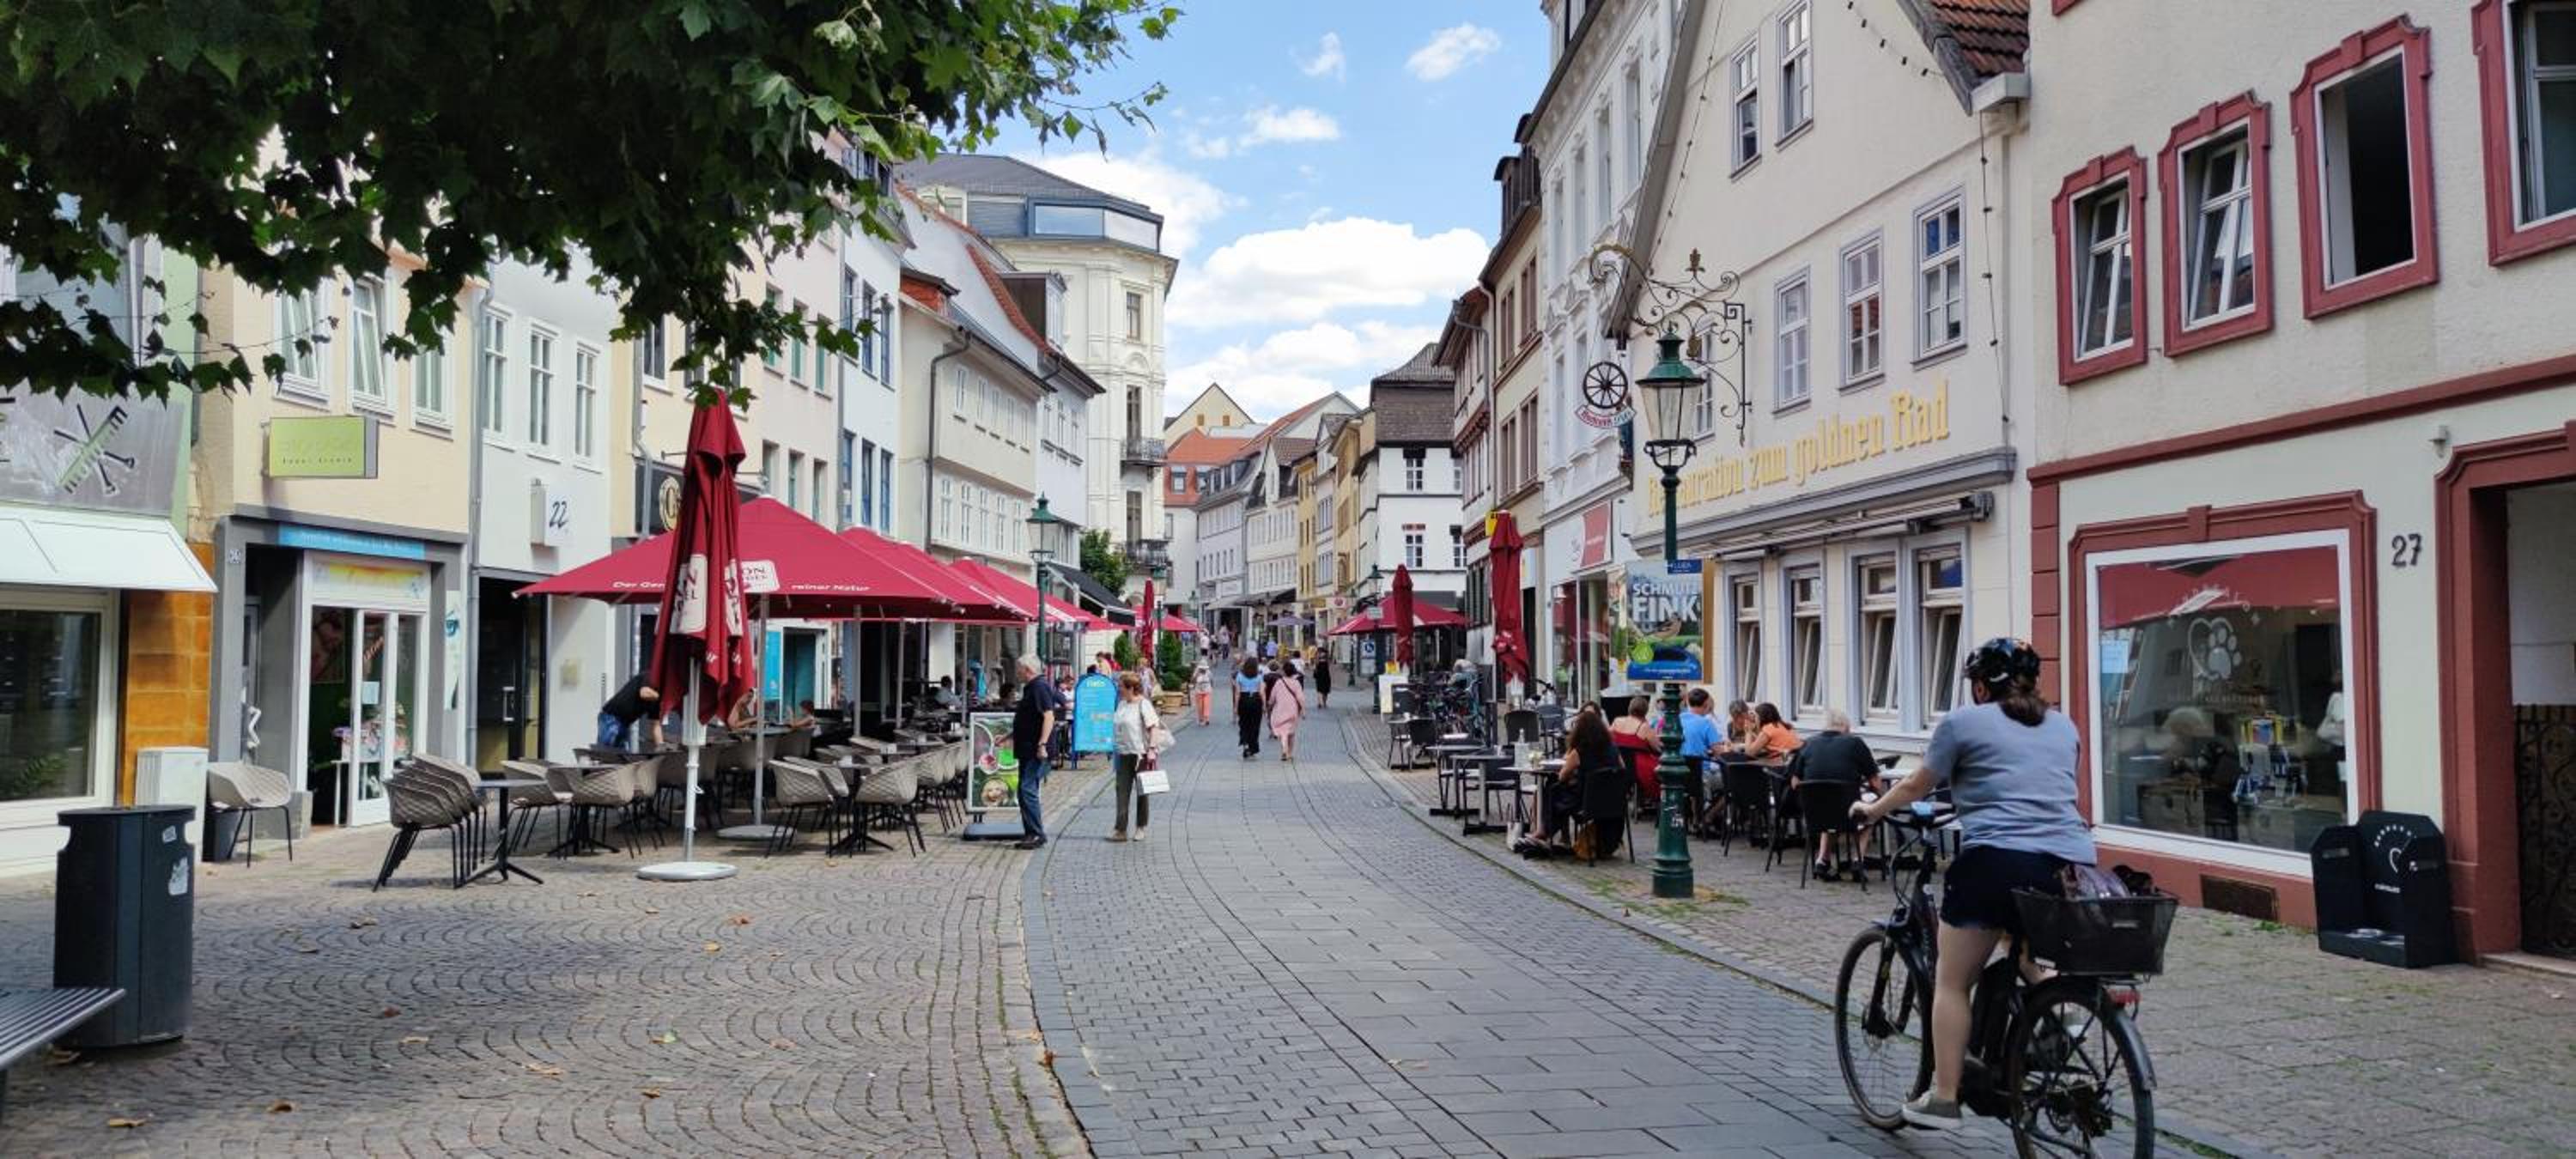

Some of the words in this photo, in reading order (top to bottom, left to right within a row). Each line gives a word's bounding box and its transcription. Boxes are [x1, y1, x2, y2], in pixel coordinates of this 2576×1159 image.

[1749, 446, 1789, 489] zum
[1795, 413, 1886, 487] goldnen
[1892, 380, 1950, 452] Rad
[550, 501, 569, 529] 22
[2391, 533, 2421, 567] 27
[1633, 583, 1698, 595] SCHMUTZ
[1632, 596, 1698, 622] FINK
